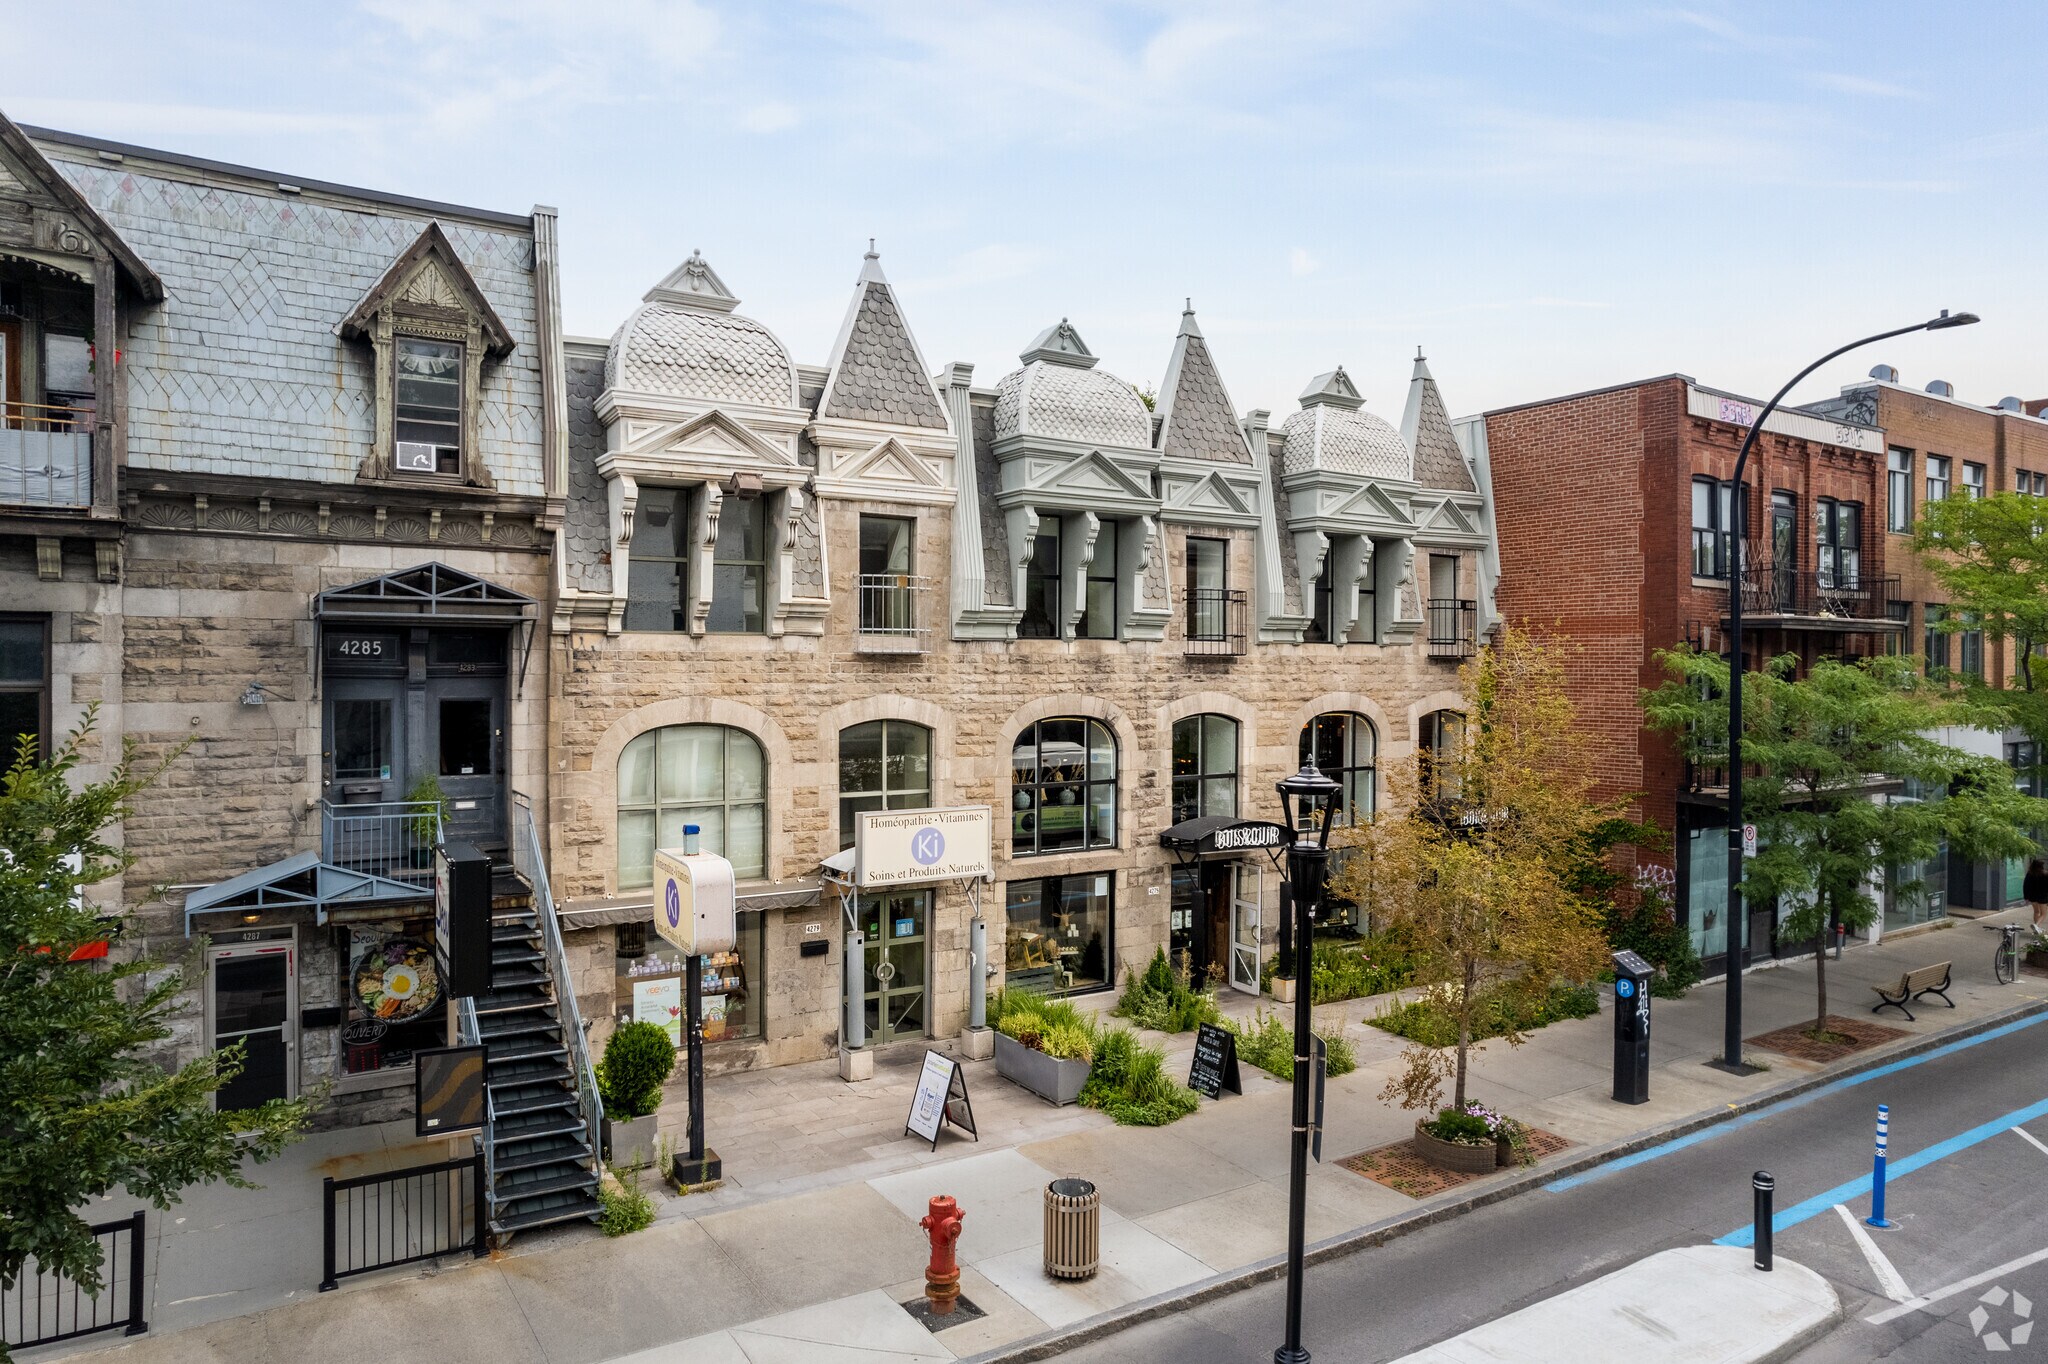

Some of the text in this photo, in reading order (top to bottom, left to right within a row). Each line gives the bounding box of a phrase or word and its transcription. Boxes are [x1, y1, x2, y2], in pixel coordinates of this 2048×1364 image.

[339, 640, 382, 655] 4285
[870, 812, 984, 829] Homéopathie Vitamines
[918, 832, 938, 859] Ki
[869, 862, 985, 882] Soins et Produits Naturels
[667, 886, 678, 920] Ki
[242, 931, 260, 941] 4287
[806, 924, 820, 933] 4279
[344, 1024, 384, 1040] OUVERT
